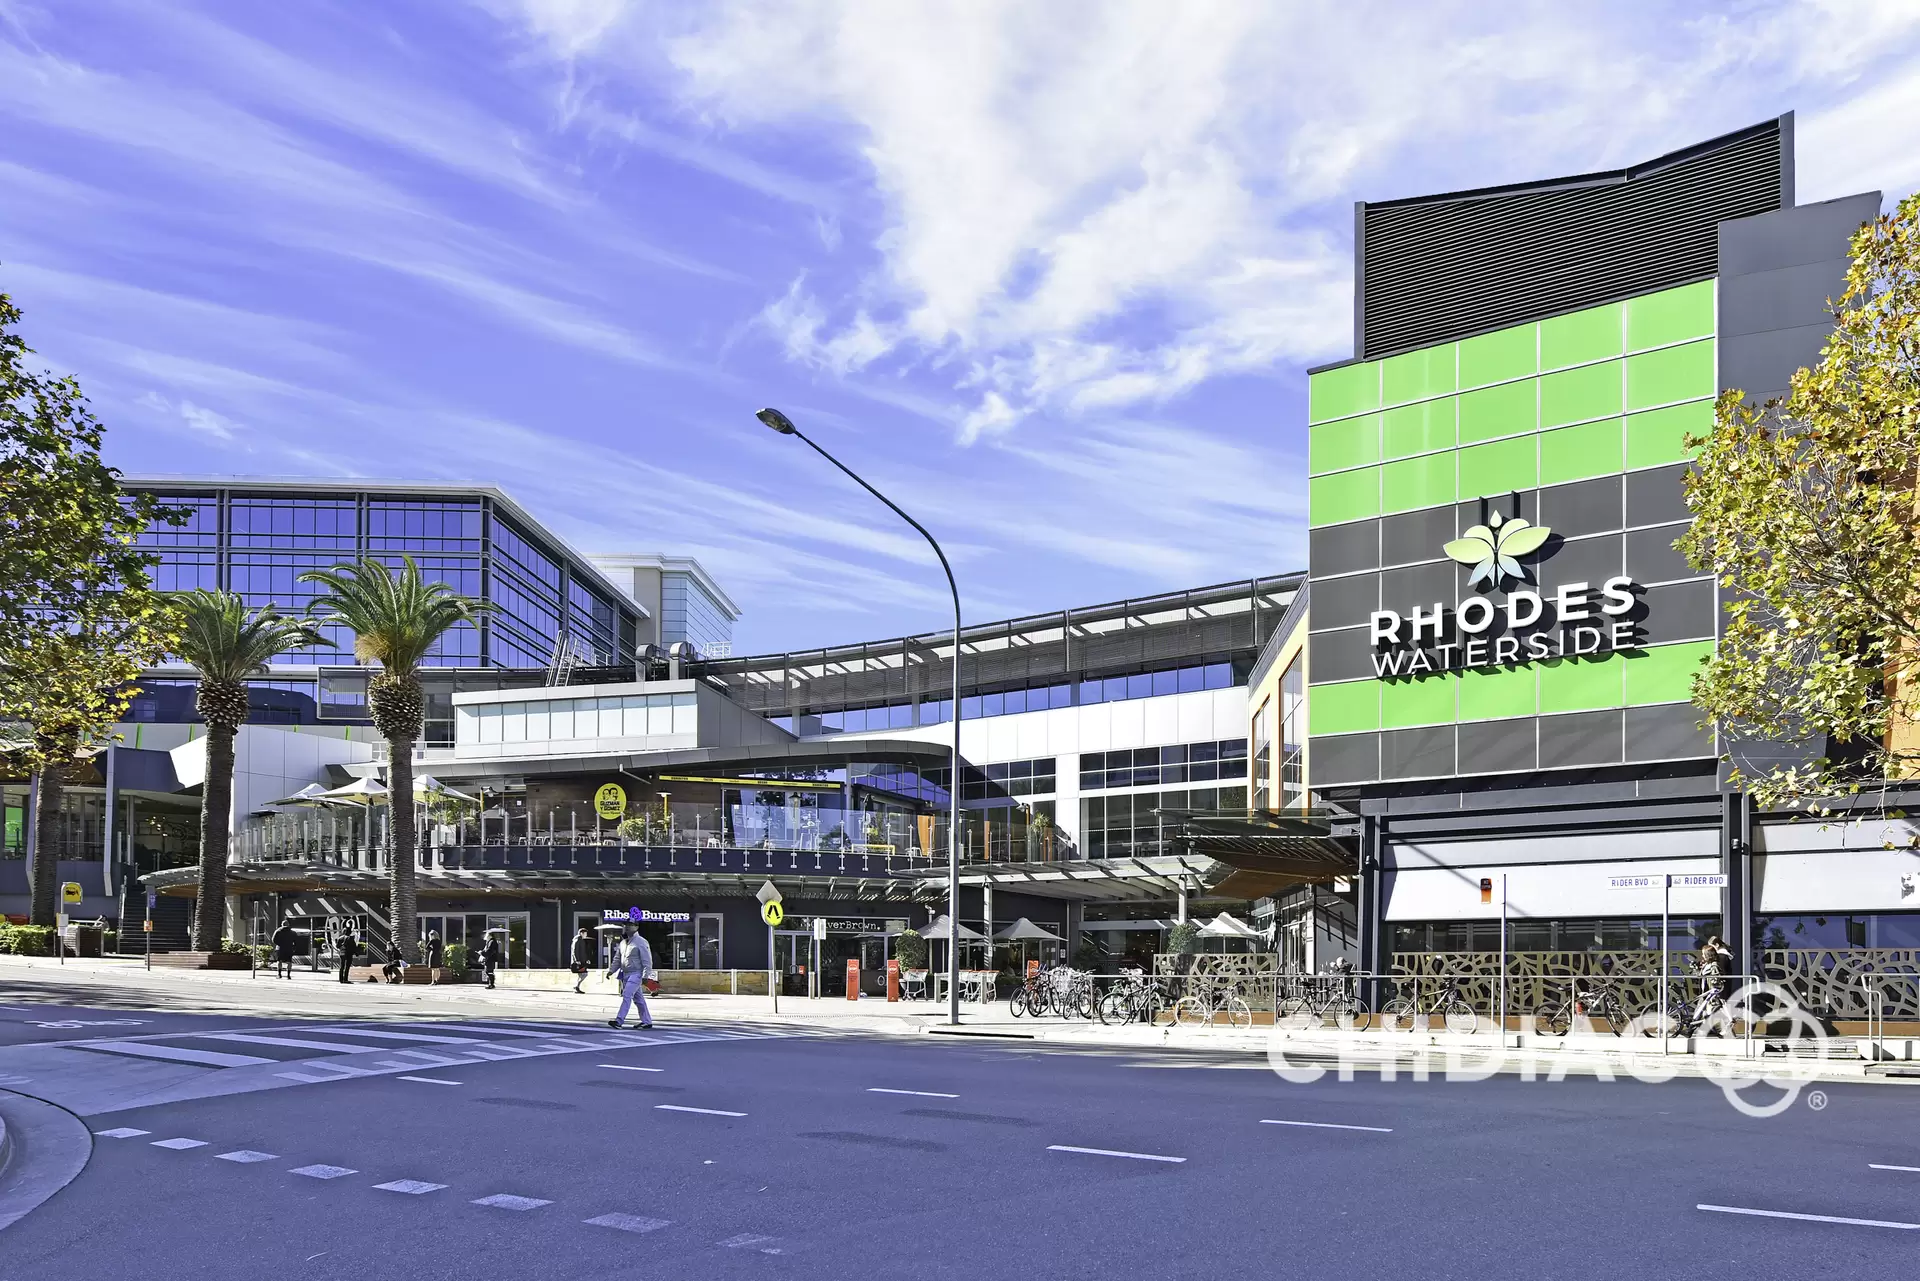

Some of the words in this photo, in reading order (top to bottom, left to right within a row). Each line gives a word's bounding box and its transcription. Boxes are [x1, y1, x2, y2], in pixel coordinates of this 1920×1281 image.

[1370, 575, 1636, 646] RHODES
[1370, 620, 1636, 677] WATERSIDE
[1611, 878, 1633, 887] RIDER
[1635, 877, 1649, 886] BVD
[1684, 876, 1707, 885] RIDER
[1709, 876, 1724, 885] BVD
[603, 909, 630, 919] Ribs
[641, 910, 690, 922] Burgers
